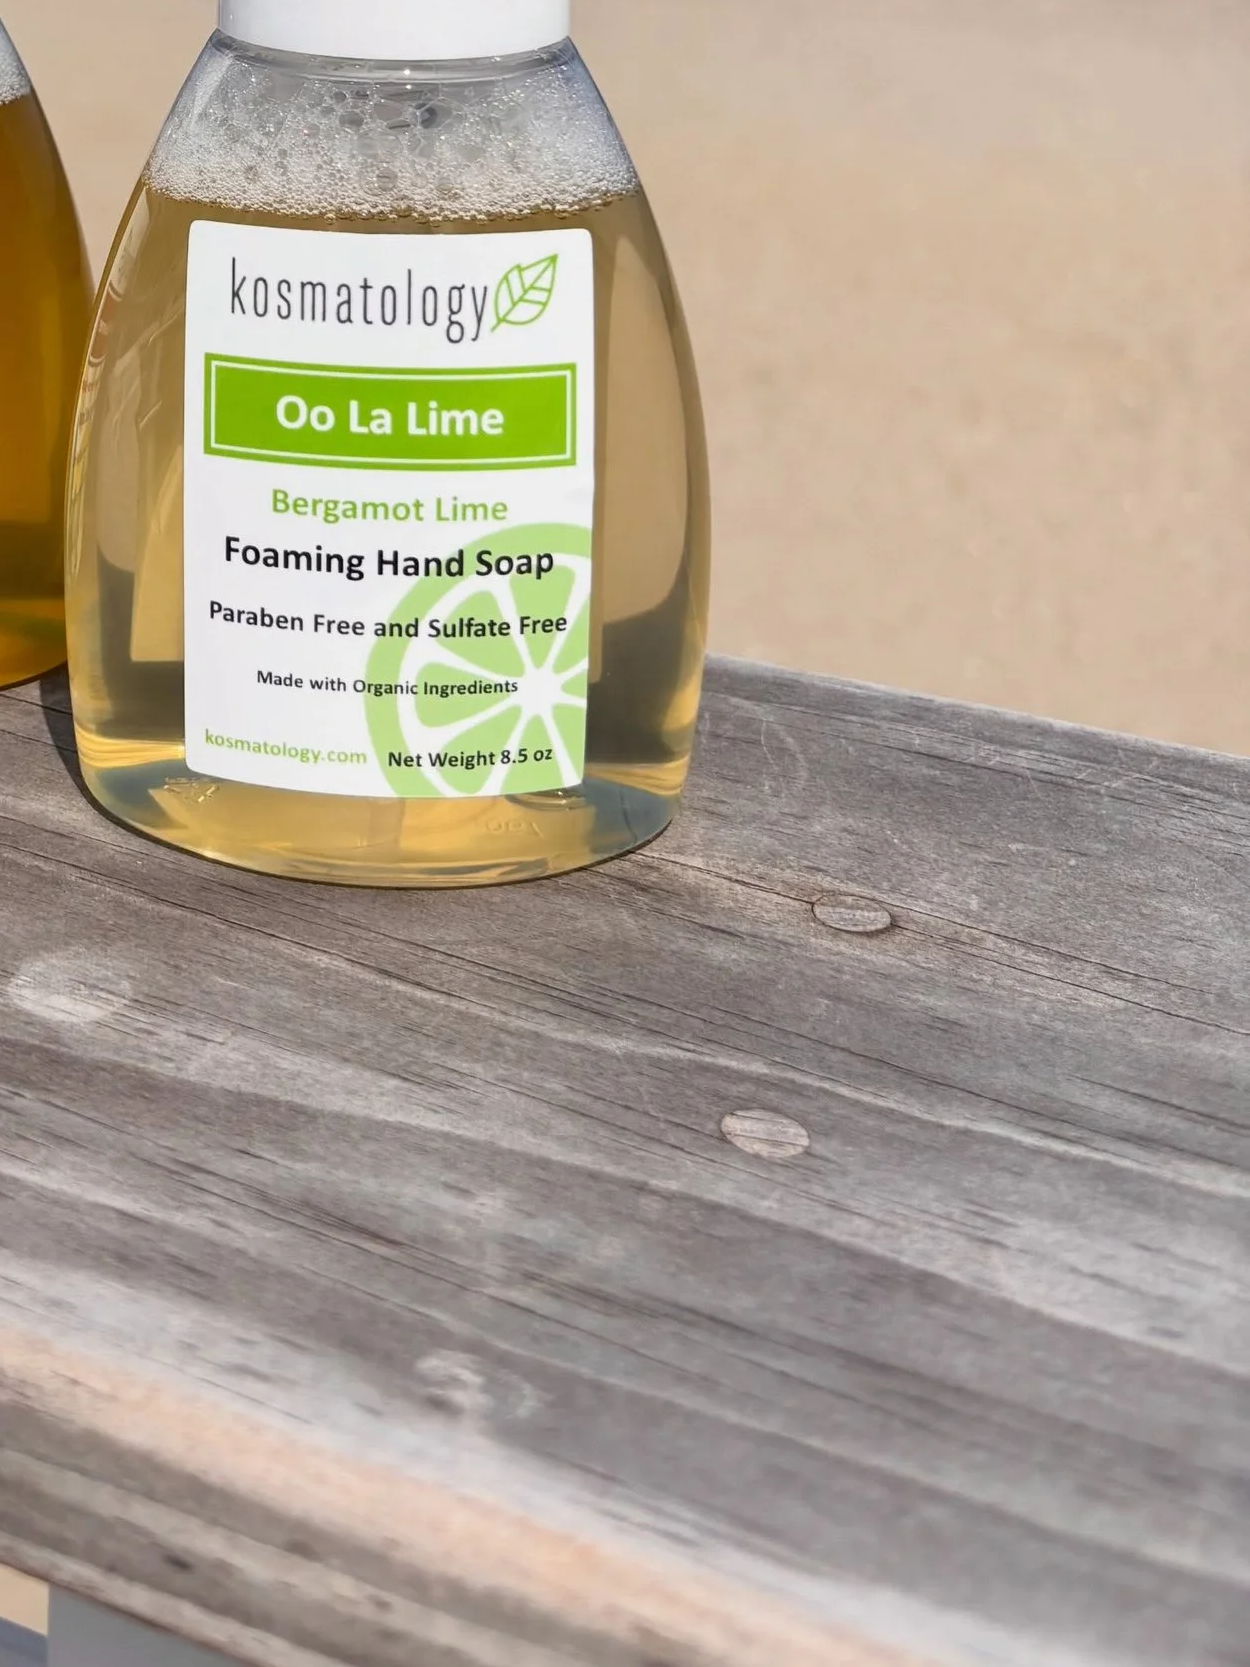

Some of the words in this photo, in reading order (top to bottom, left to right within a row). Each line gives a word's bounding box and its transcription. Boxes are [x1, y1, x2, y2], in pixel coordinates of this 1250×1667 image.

[230, 256, 488, 344] kosmatology
[276, 394, 335, 432] Oo
[349, 399, 391, 435] La
[407, 401, 505, 436] Lime
[272, 489, 424, 524] Bergamot
[435, 496, 508, 522] Lime
[224, 535, 365, 581] Foaming
[376, 549, 464, 577] Hand
[475, 550, 554, 580] Soap
[210, 600, 304, 632] Paraben
[313, 614, 365, 636] Free
[373, 617, 419, 638] and
[428, 617, 511, 639] Sulfate
[519, 615, 568, 635] Free
[256, 670, 304, 689] Made
[309, 676, 347, 693] with
[353, 679, 418, 697] Organic
[423, 679, 518, 698] Ingredients
[205, 728, 367, 765] kosmatology.com
[388, 750, 422, 768] Net
[428, 749, 495, 770] Weight
[500, 748, 528, 765] 8.5
[533, 747, 553, 763] oz
